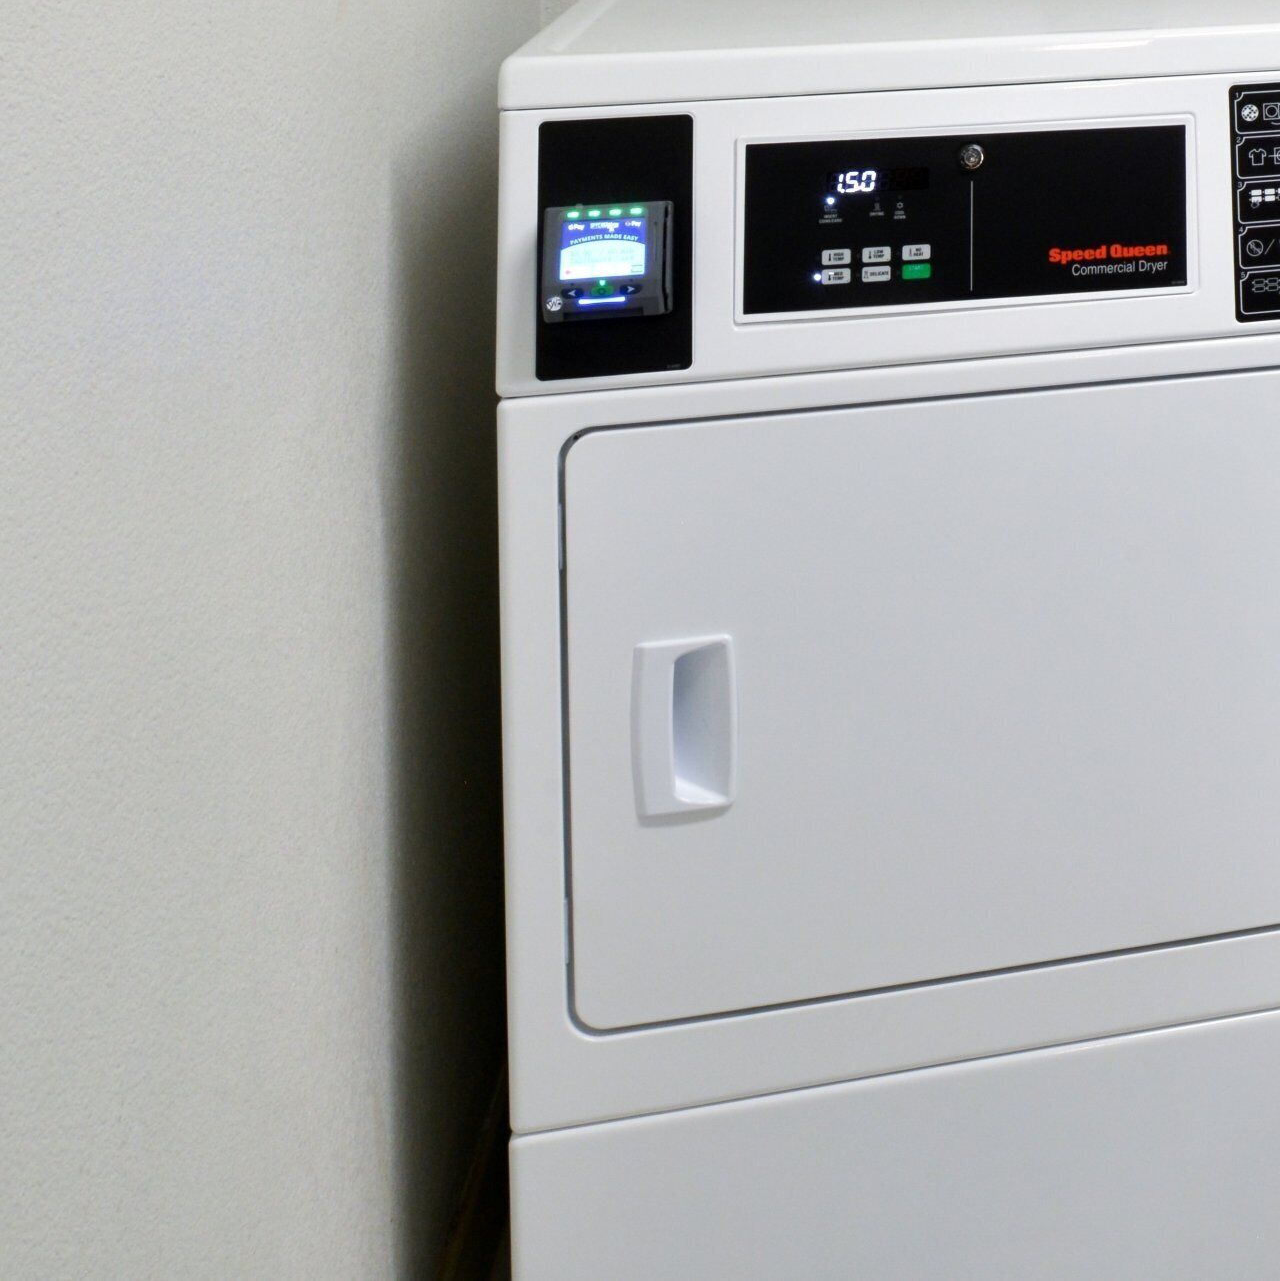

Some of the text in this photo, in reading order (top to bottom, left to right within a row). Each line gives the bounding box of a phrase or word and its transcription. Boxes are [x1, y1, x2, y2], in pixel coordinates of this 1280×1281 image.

[569, 234, 604, 245] PAYMENTS
[623, 234, 639, 242] EASY
[1048, 243, 1169, 265] Speed Queen
[1071, 259, 1169, 276] Commercial Dryer
